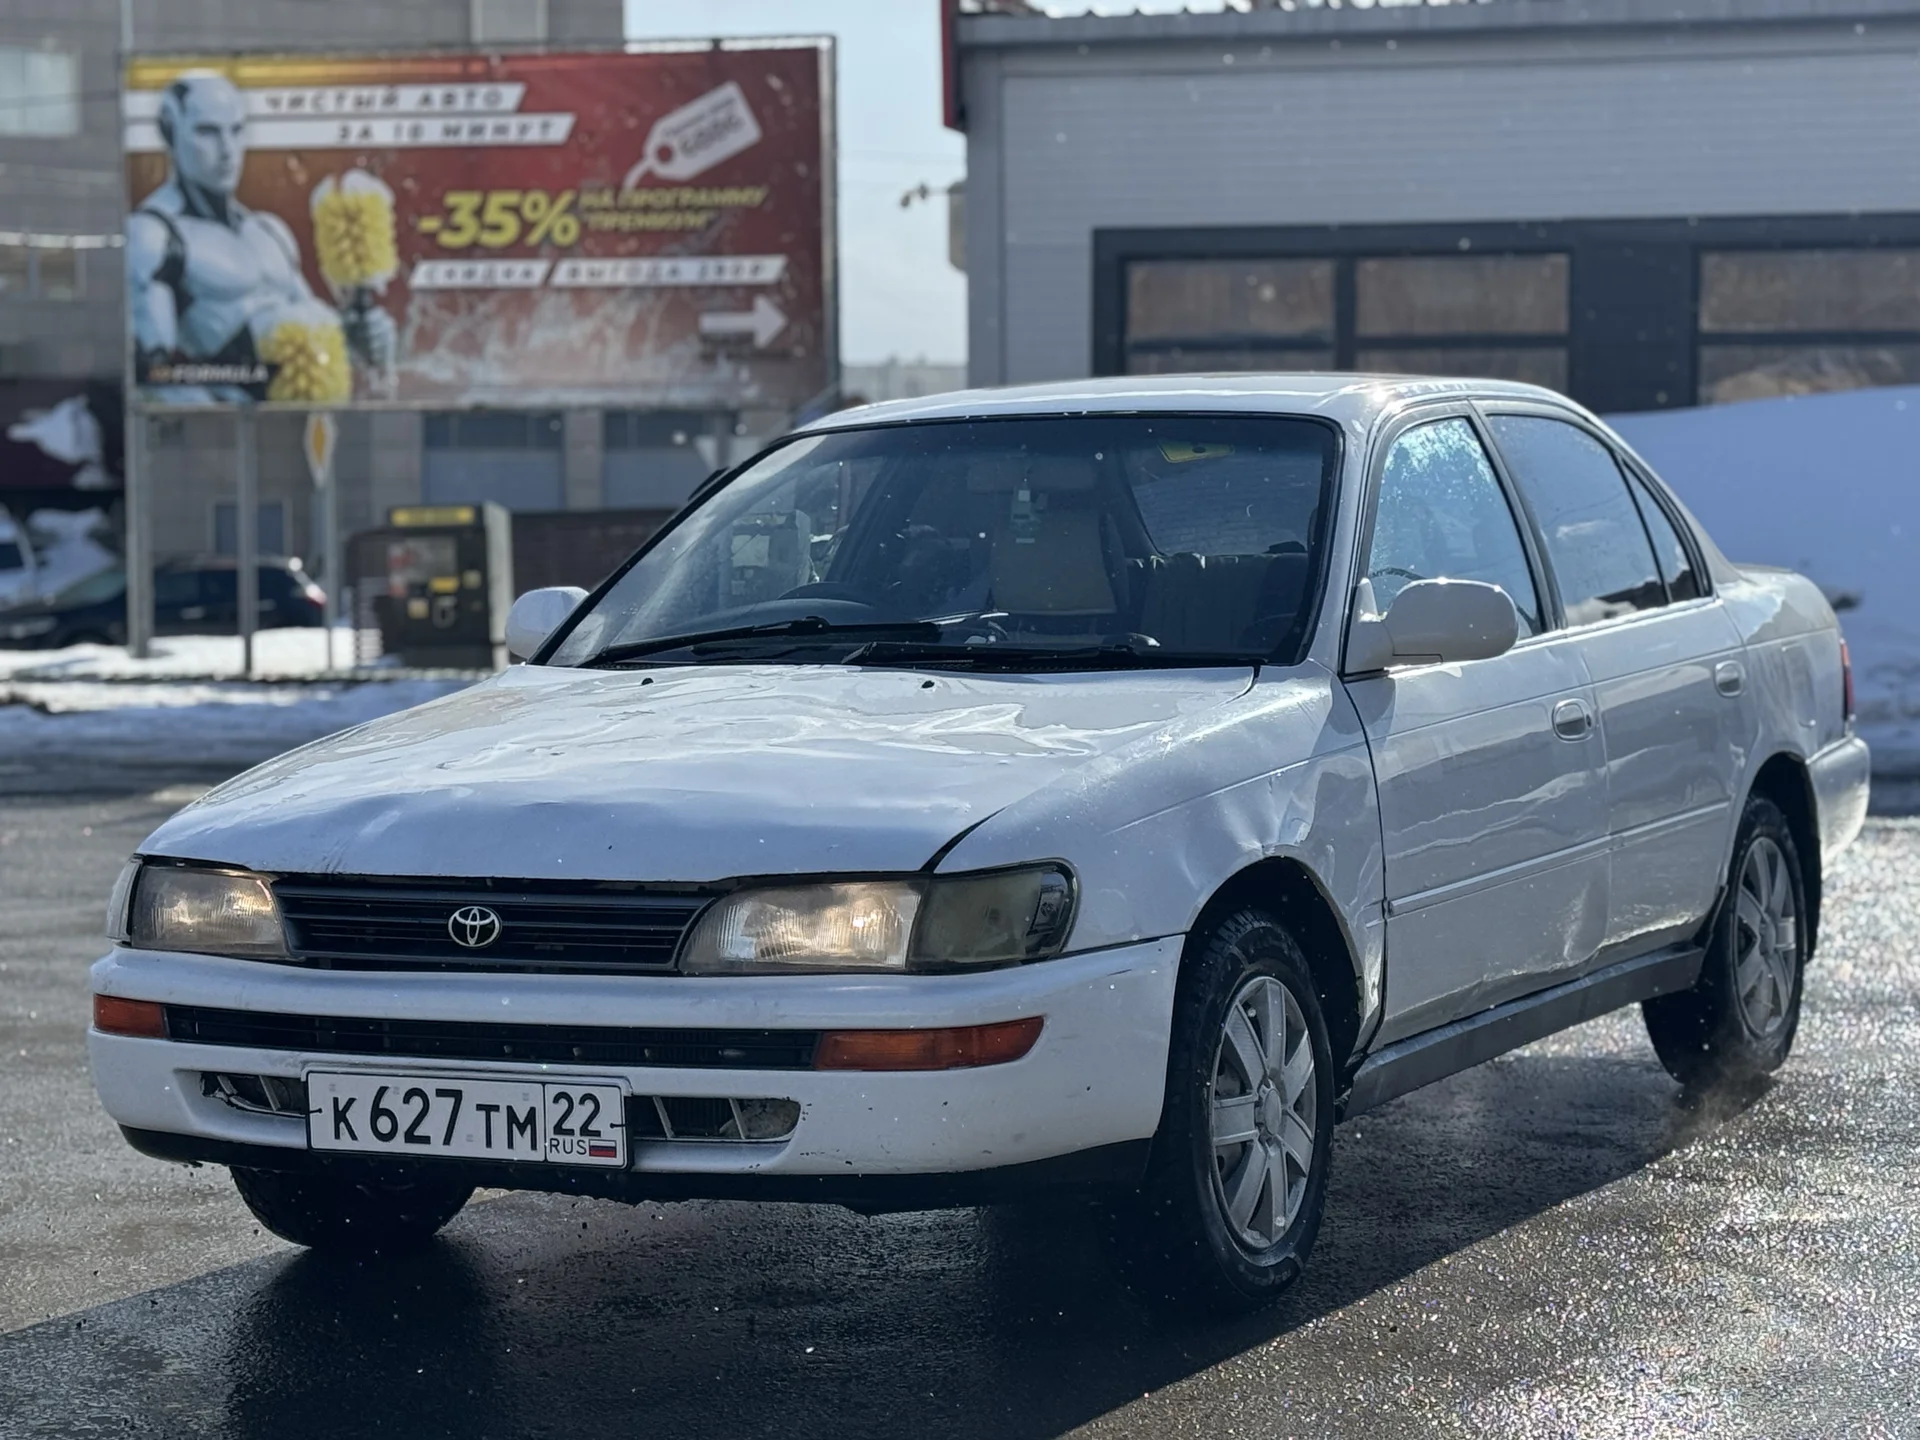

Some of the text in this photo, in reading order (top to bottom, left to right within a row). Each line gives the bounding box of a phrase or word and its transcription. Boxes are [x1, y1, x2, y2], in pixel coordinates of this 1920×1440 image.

[264, 88, 505, 111] ЧИСТЫЙ АВТО
[337, 119, 556, 141] ЗА 10 МИНУТ
[578, 185, 770, 209] НА ПРОГРАММУ
[416, 189, 581, 247] -35%
[423, 263, 536, 282] СКИДКА
[565, 262, 684, 282] ВЫГОДА
[551, 1090, 602, 1138] 22
[549, 1137, 588, 1156] RUS
